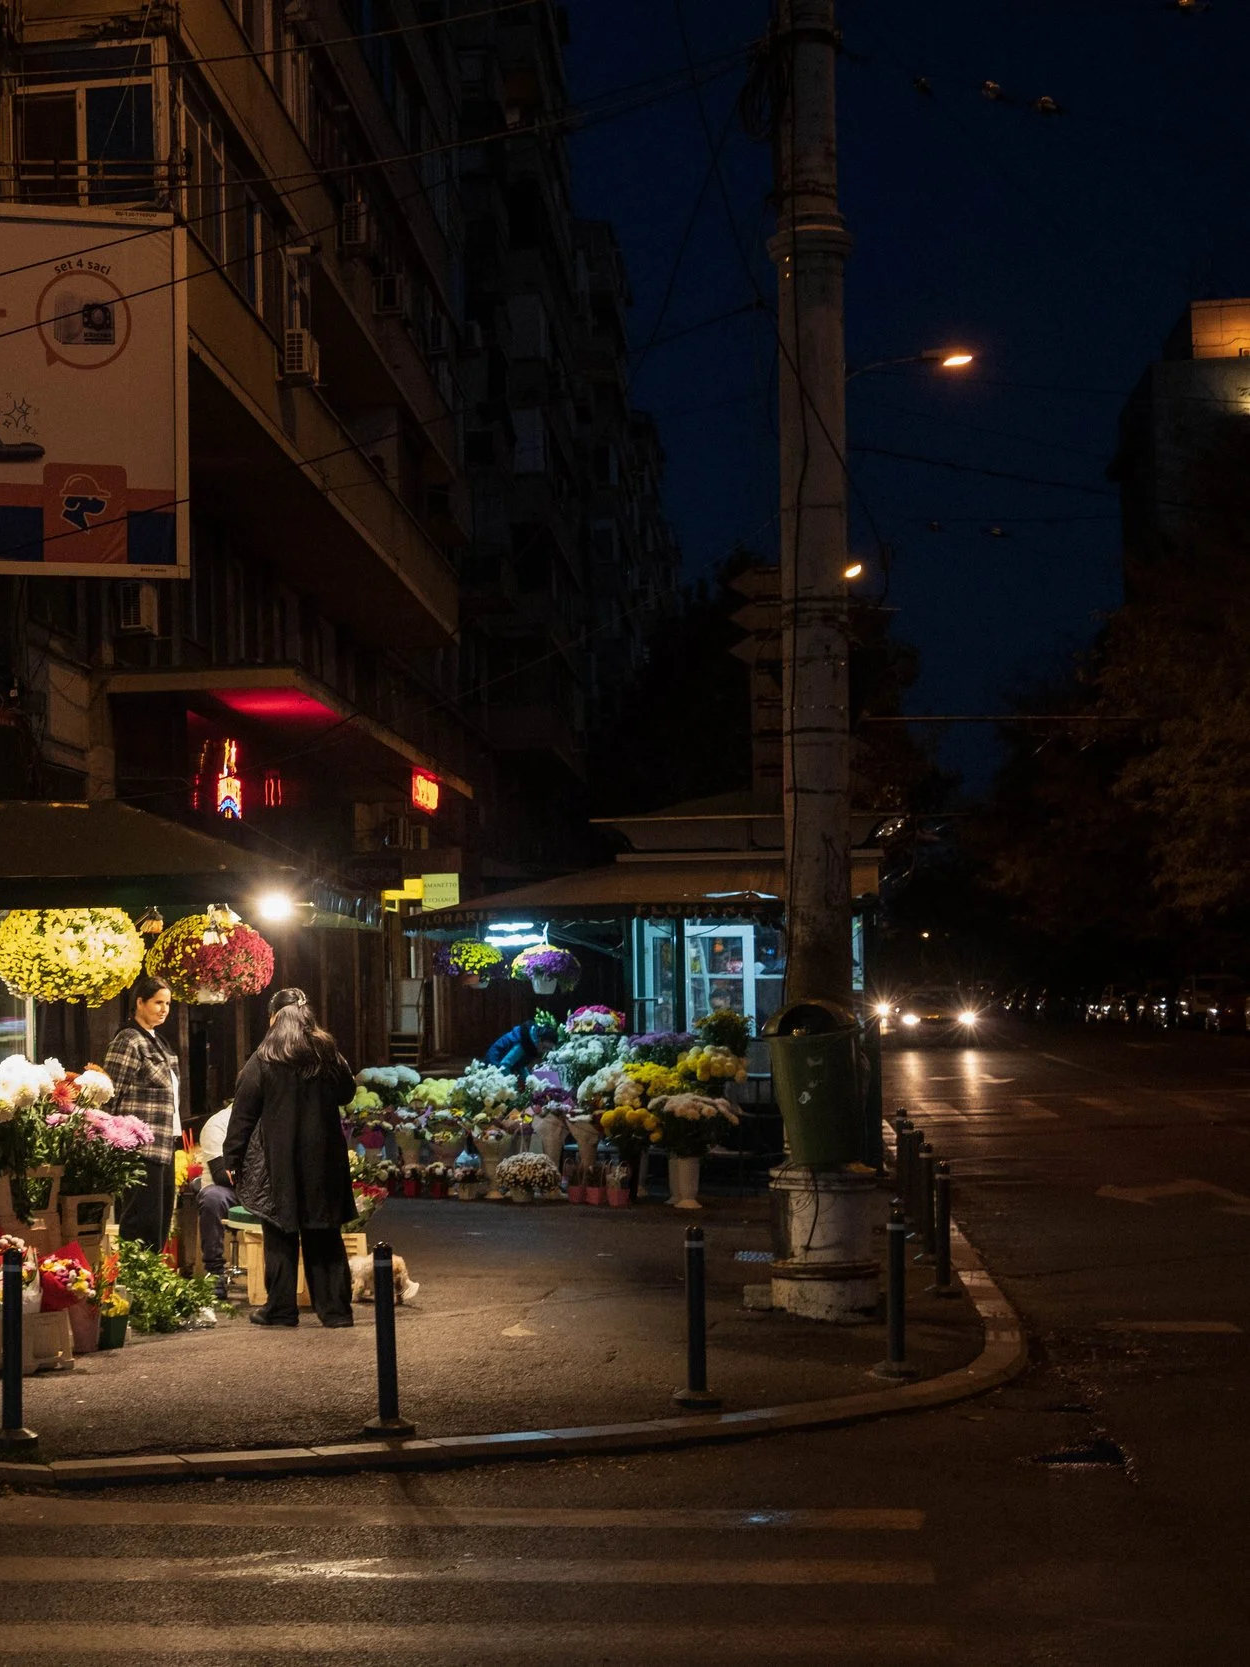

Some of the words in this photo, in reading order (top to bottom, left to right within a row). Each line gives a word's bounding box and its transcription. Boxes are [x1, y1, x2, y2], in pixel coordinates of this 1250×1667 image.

[54, 260, 73, 275] set
[76, 258, 84, 269] 4
[87, 261, 112, 276] saci
